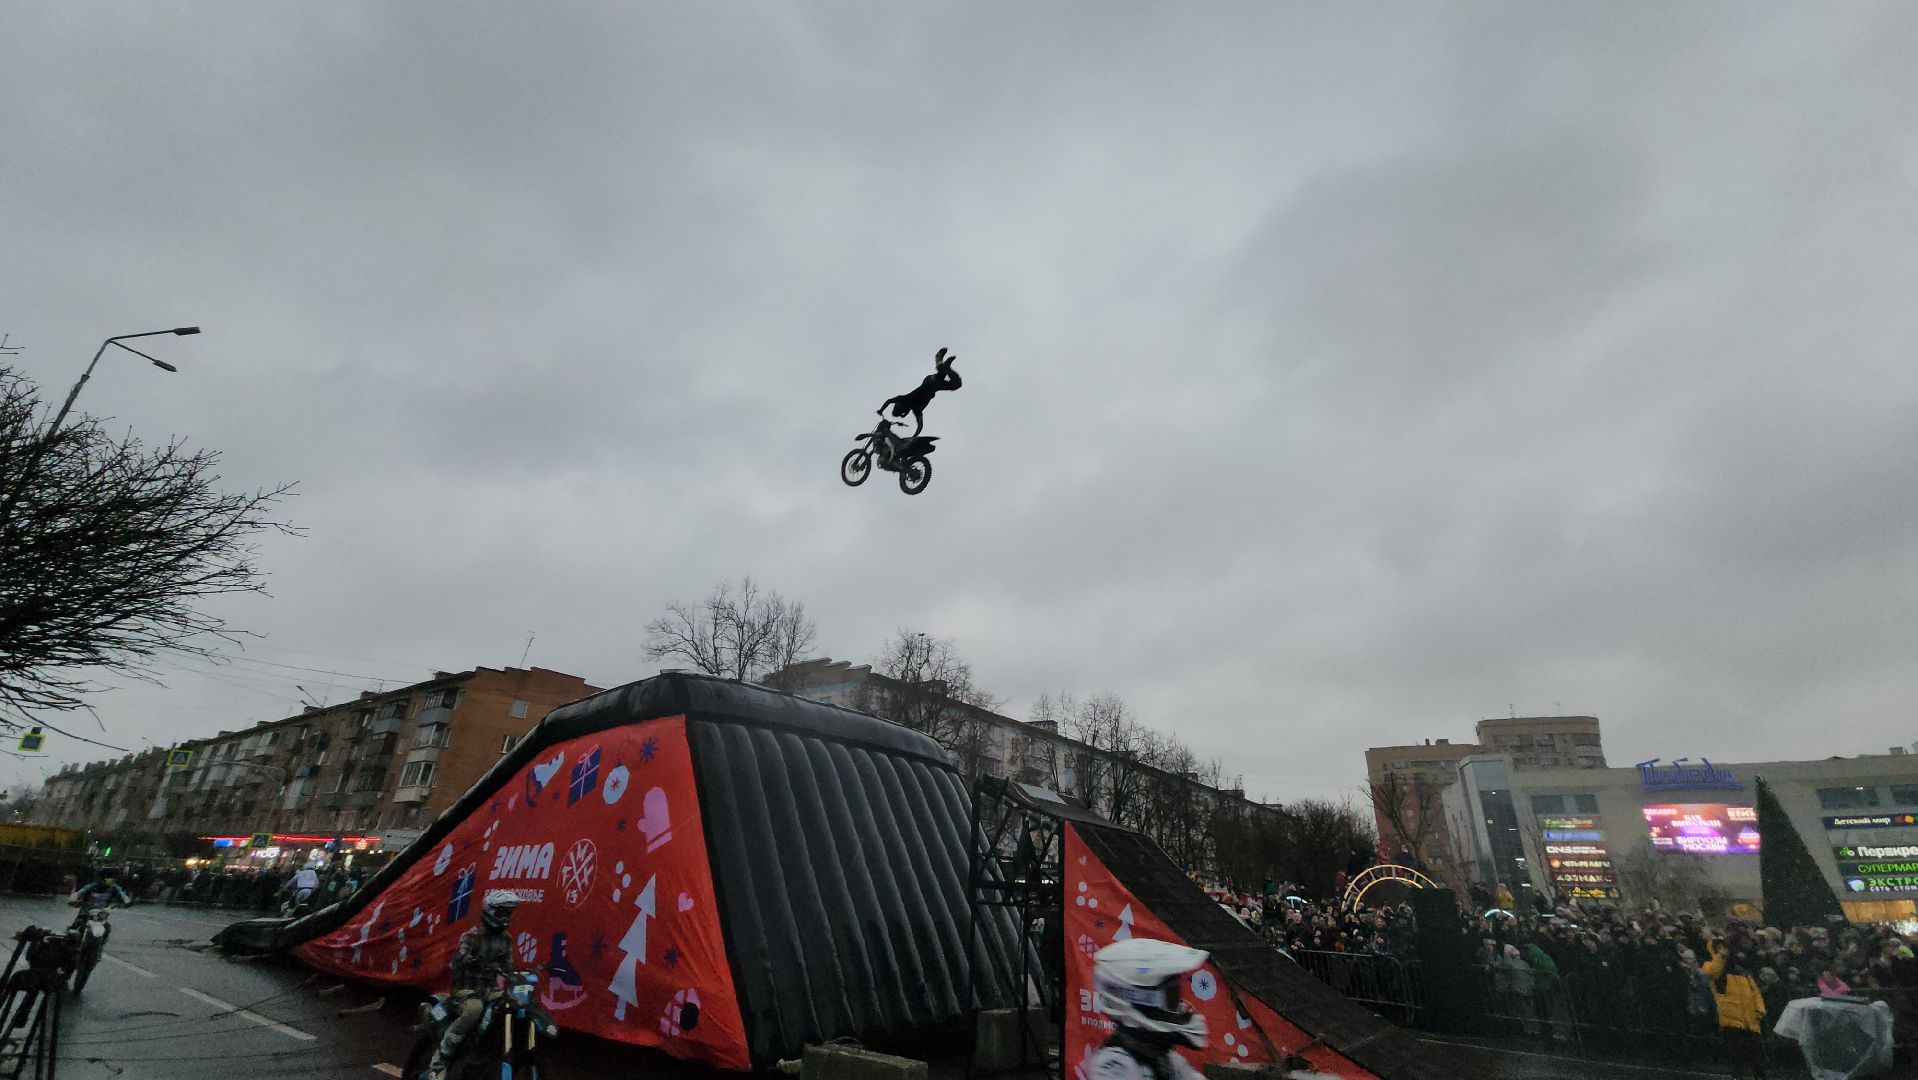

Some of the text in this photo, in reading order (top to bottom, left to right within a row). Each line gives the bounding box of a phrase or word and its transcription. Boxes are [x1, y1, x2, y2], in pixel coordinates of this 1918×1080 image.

[1834, 817, 1891, 825] Детский мир
[1677, 836, 1728, 845] ВИРТУОЗЫ
[1545, 846, 1573, 854] DNS
[1683, 844, 1727, 852] МОСКВЫ
[489, 842, 555, 880] ЗИМА
